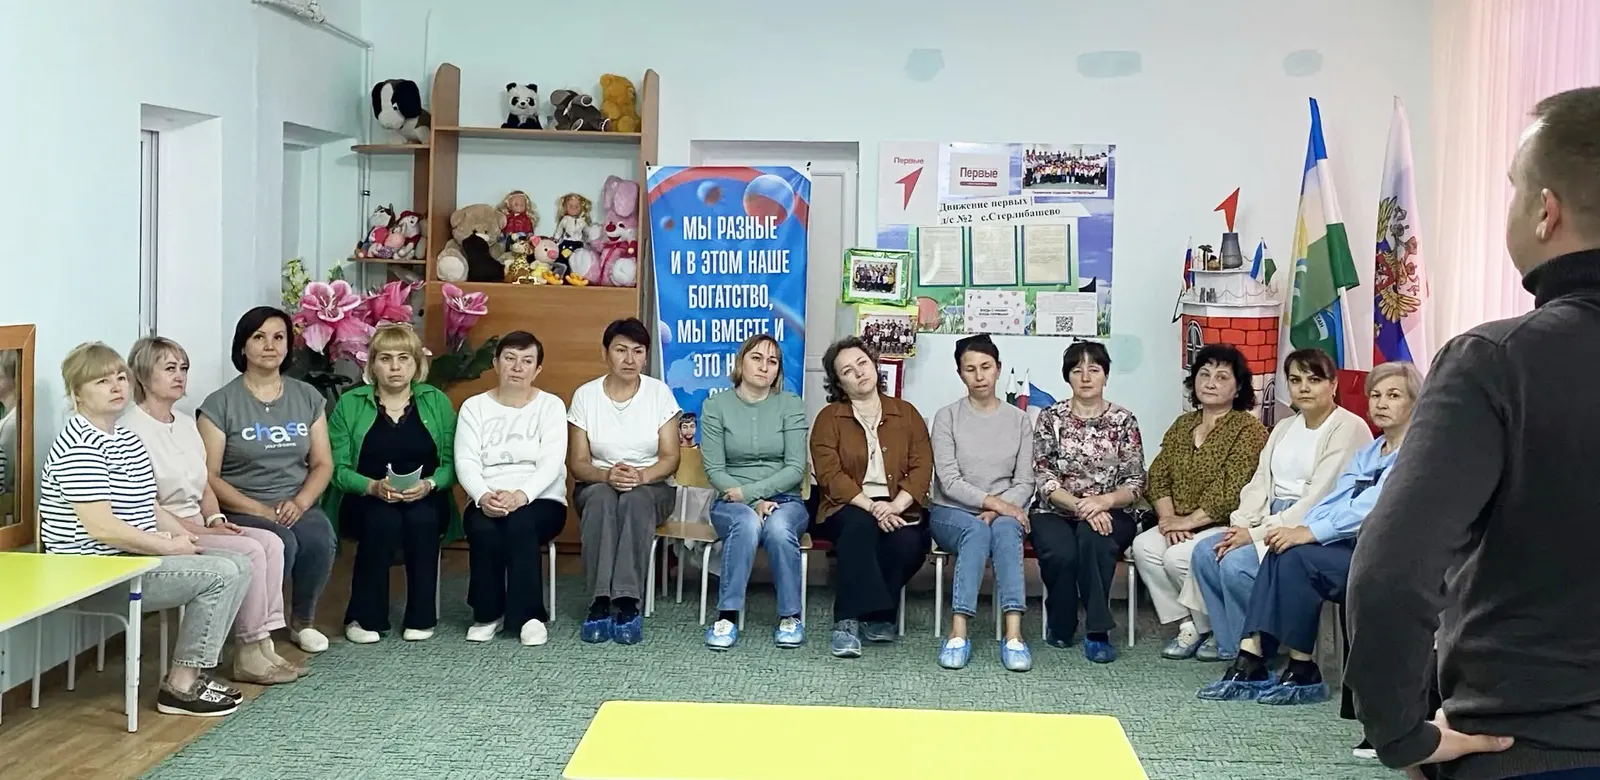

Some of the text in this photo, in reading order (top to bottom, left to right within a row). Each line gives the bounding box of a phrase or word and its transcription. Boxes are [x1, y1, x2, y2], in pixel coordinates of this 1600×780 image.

[893, 156, 925, 165] Первые
[960, 167, 998, 180] Первые
[939, 197, 1028, 212] Движение первых
[956, 214, 973, 223] №2
[980, 208, 1061, 222] с.Стерлибашево
[683, 215, 778, 240] МЫ РАЗНЫЕ
[671, 249, 790, 274] И В ЭТОМ НАШЕ
[688, 284, 774, 310] БОГАТСТВО,
[677, 318, 784, 343] МЫ ВМЕСТЕ И
[693, 353, 720, 377] ЭТО
[241, 422, 309, 443] chase
